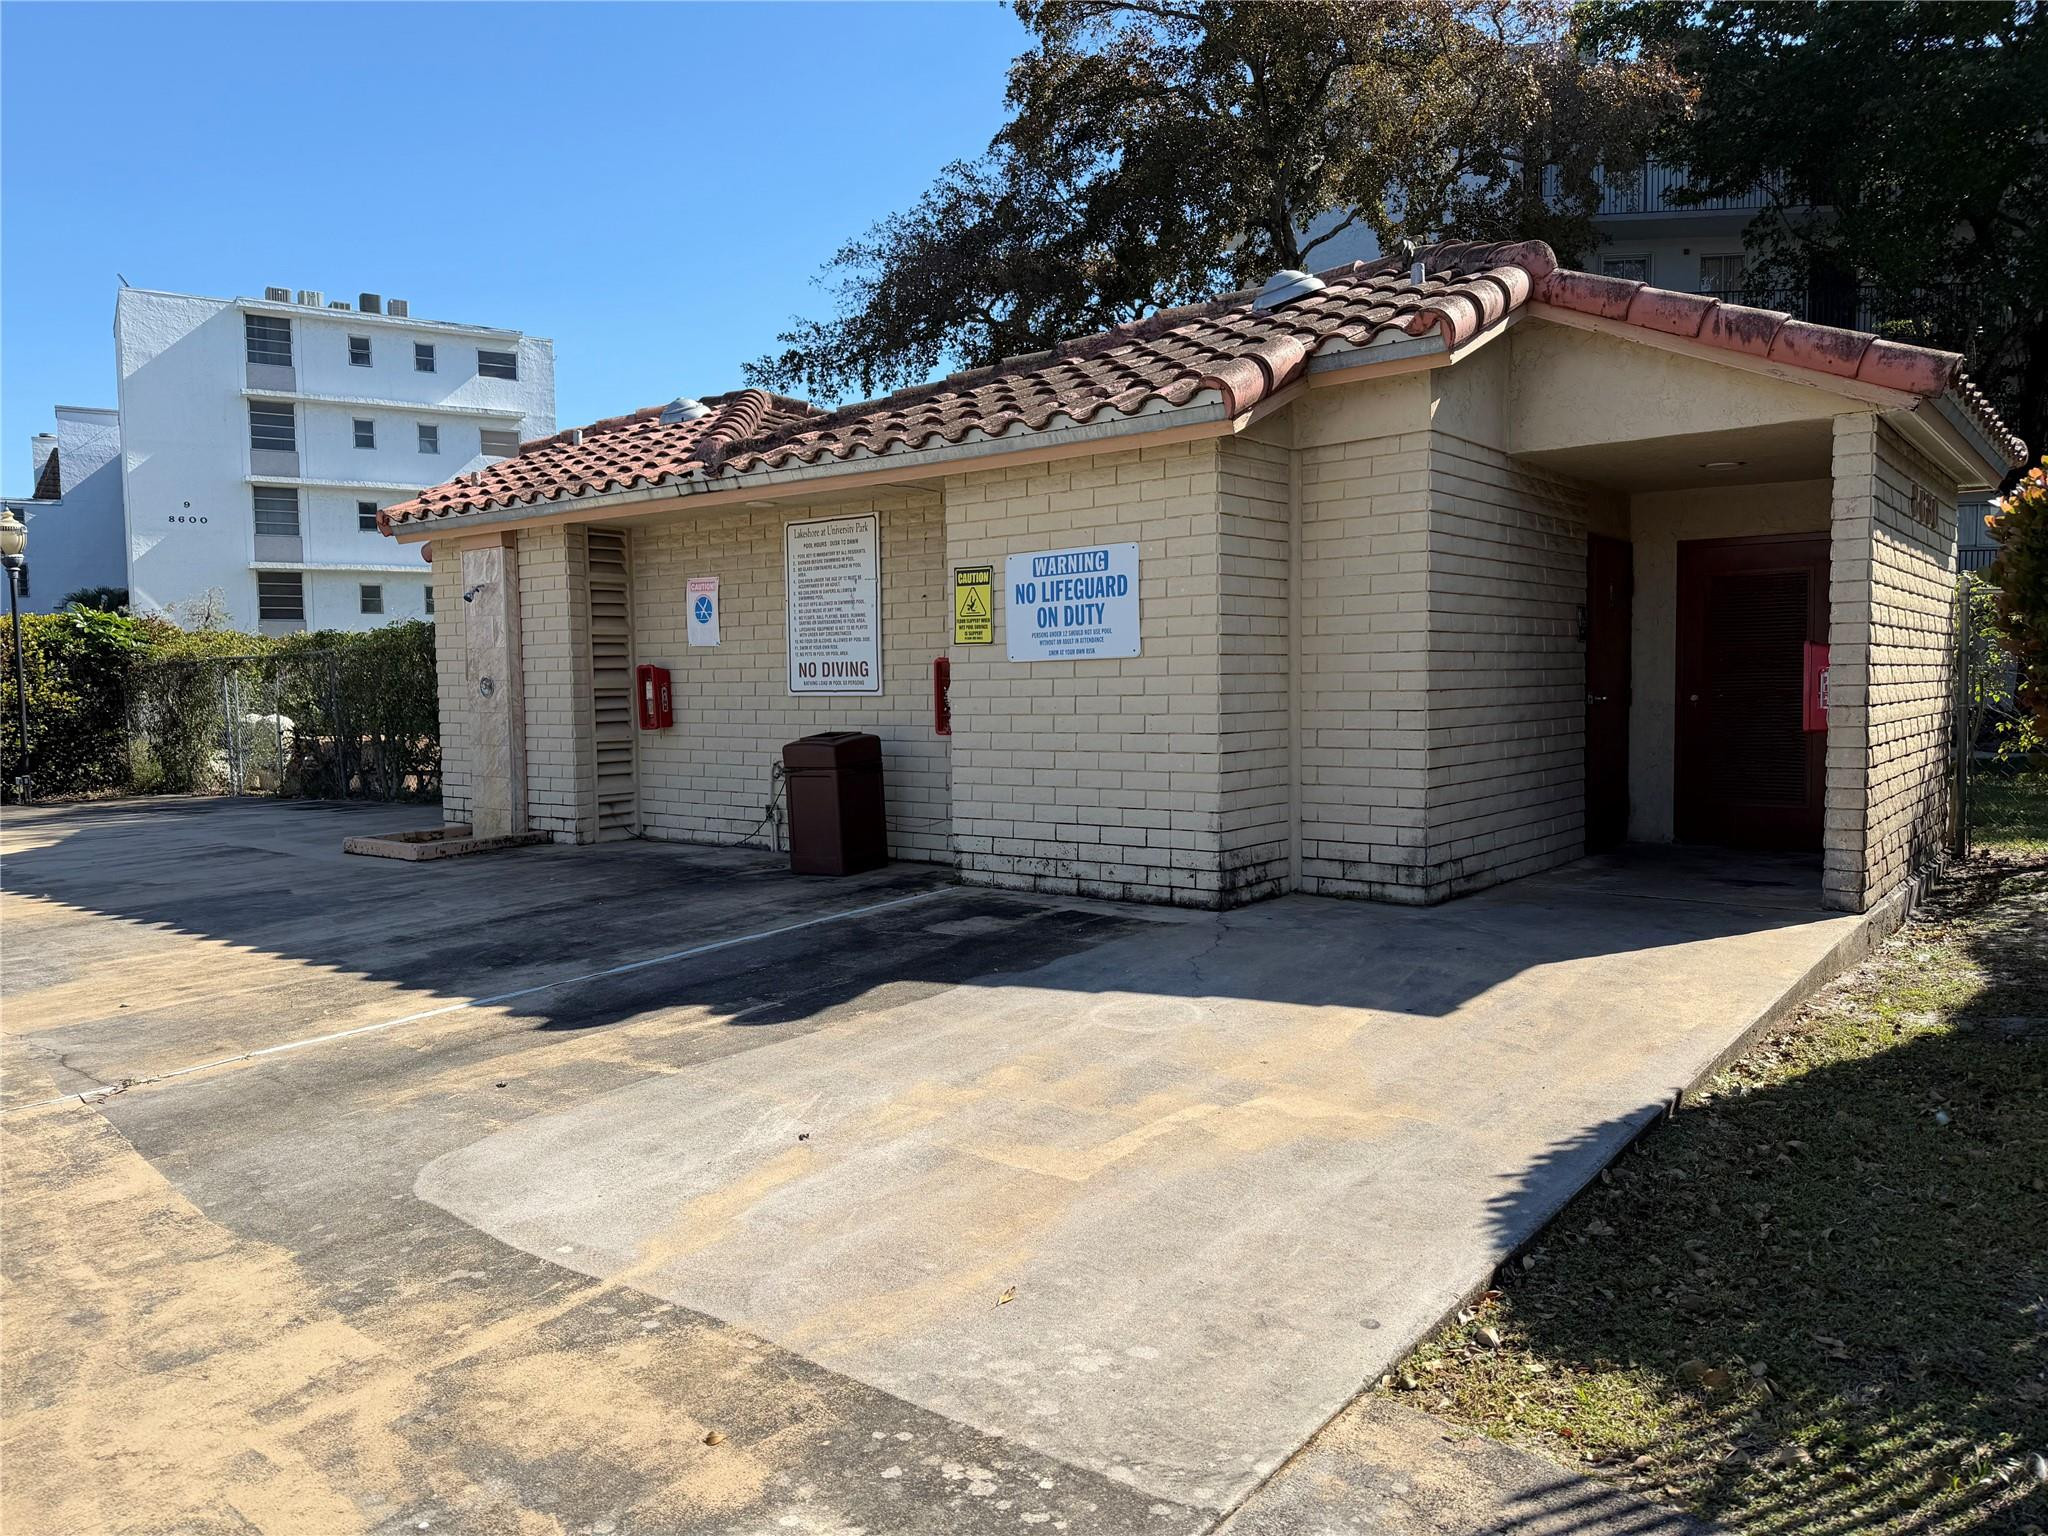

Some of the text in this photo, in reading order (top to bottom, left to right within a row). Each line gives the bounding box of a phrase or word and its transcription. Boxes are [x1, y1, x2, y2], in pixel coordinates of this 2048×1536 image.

[168, 515, 208, 524] 8600
[794, 522, 868, 539] Lakeshore at University Park
[1035, 552, 1105, 576] WARNING
[958, 571, 988, 584] CAUTION
[1016, 575, 1128, 604] NO LIFEGUARD
[1037, 603, 1105, 628] ON DUTY
[799, 661, 868, 678] NO DIVING
